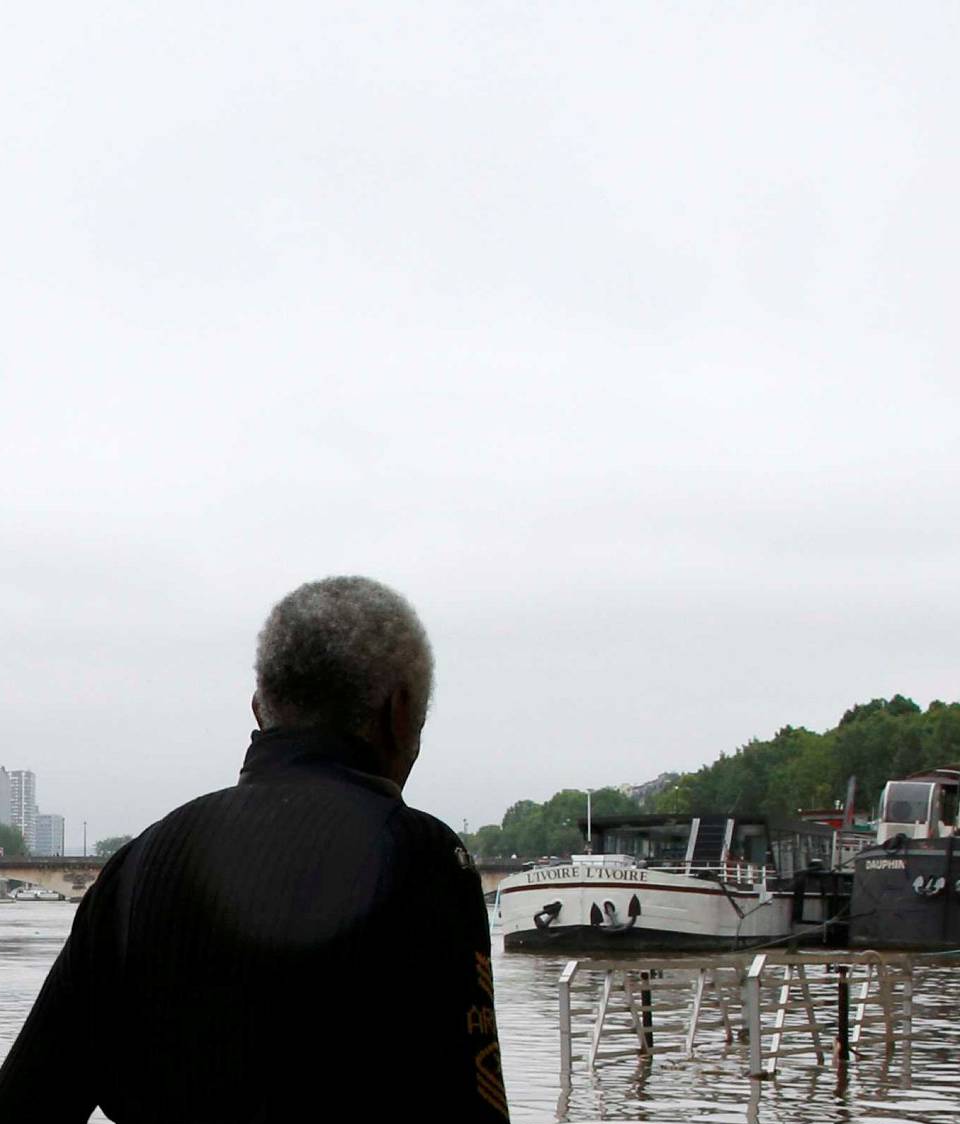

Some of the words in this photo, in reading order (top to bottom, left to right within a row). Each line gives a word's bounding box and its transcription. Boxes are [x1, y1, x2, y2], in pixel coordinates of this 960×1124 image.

[865, 859, 905, 870] DAUPHIN
[526, 866, 580, 883] L'IVOIRE
[586, 867, 648, 882] L'IVOIRE
